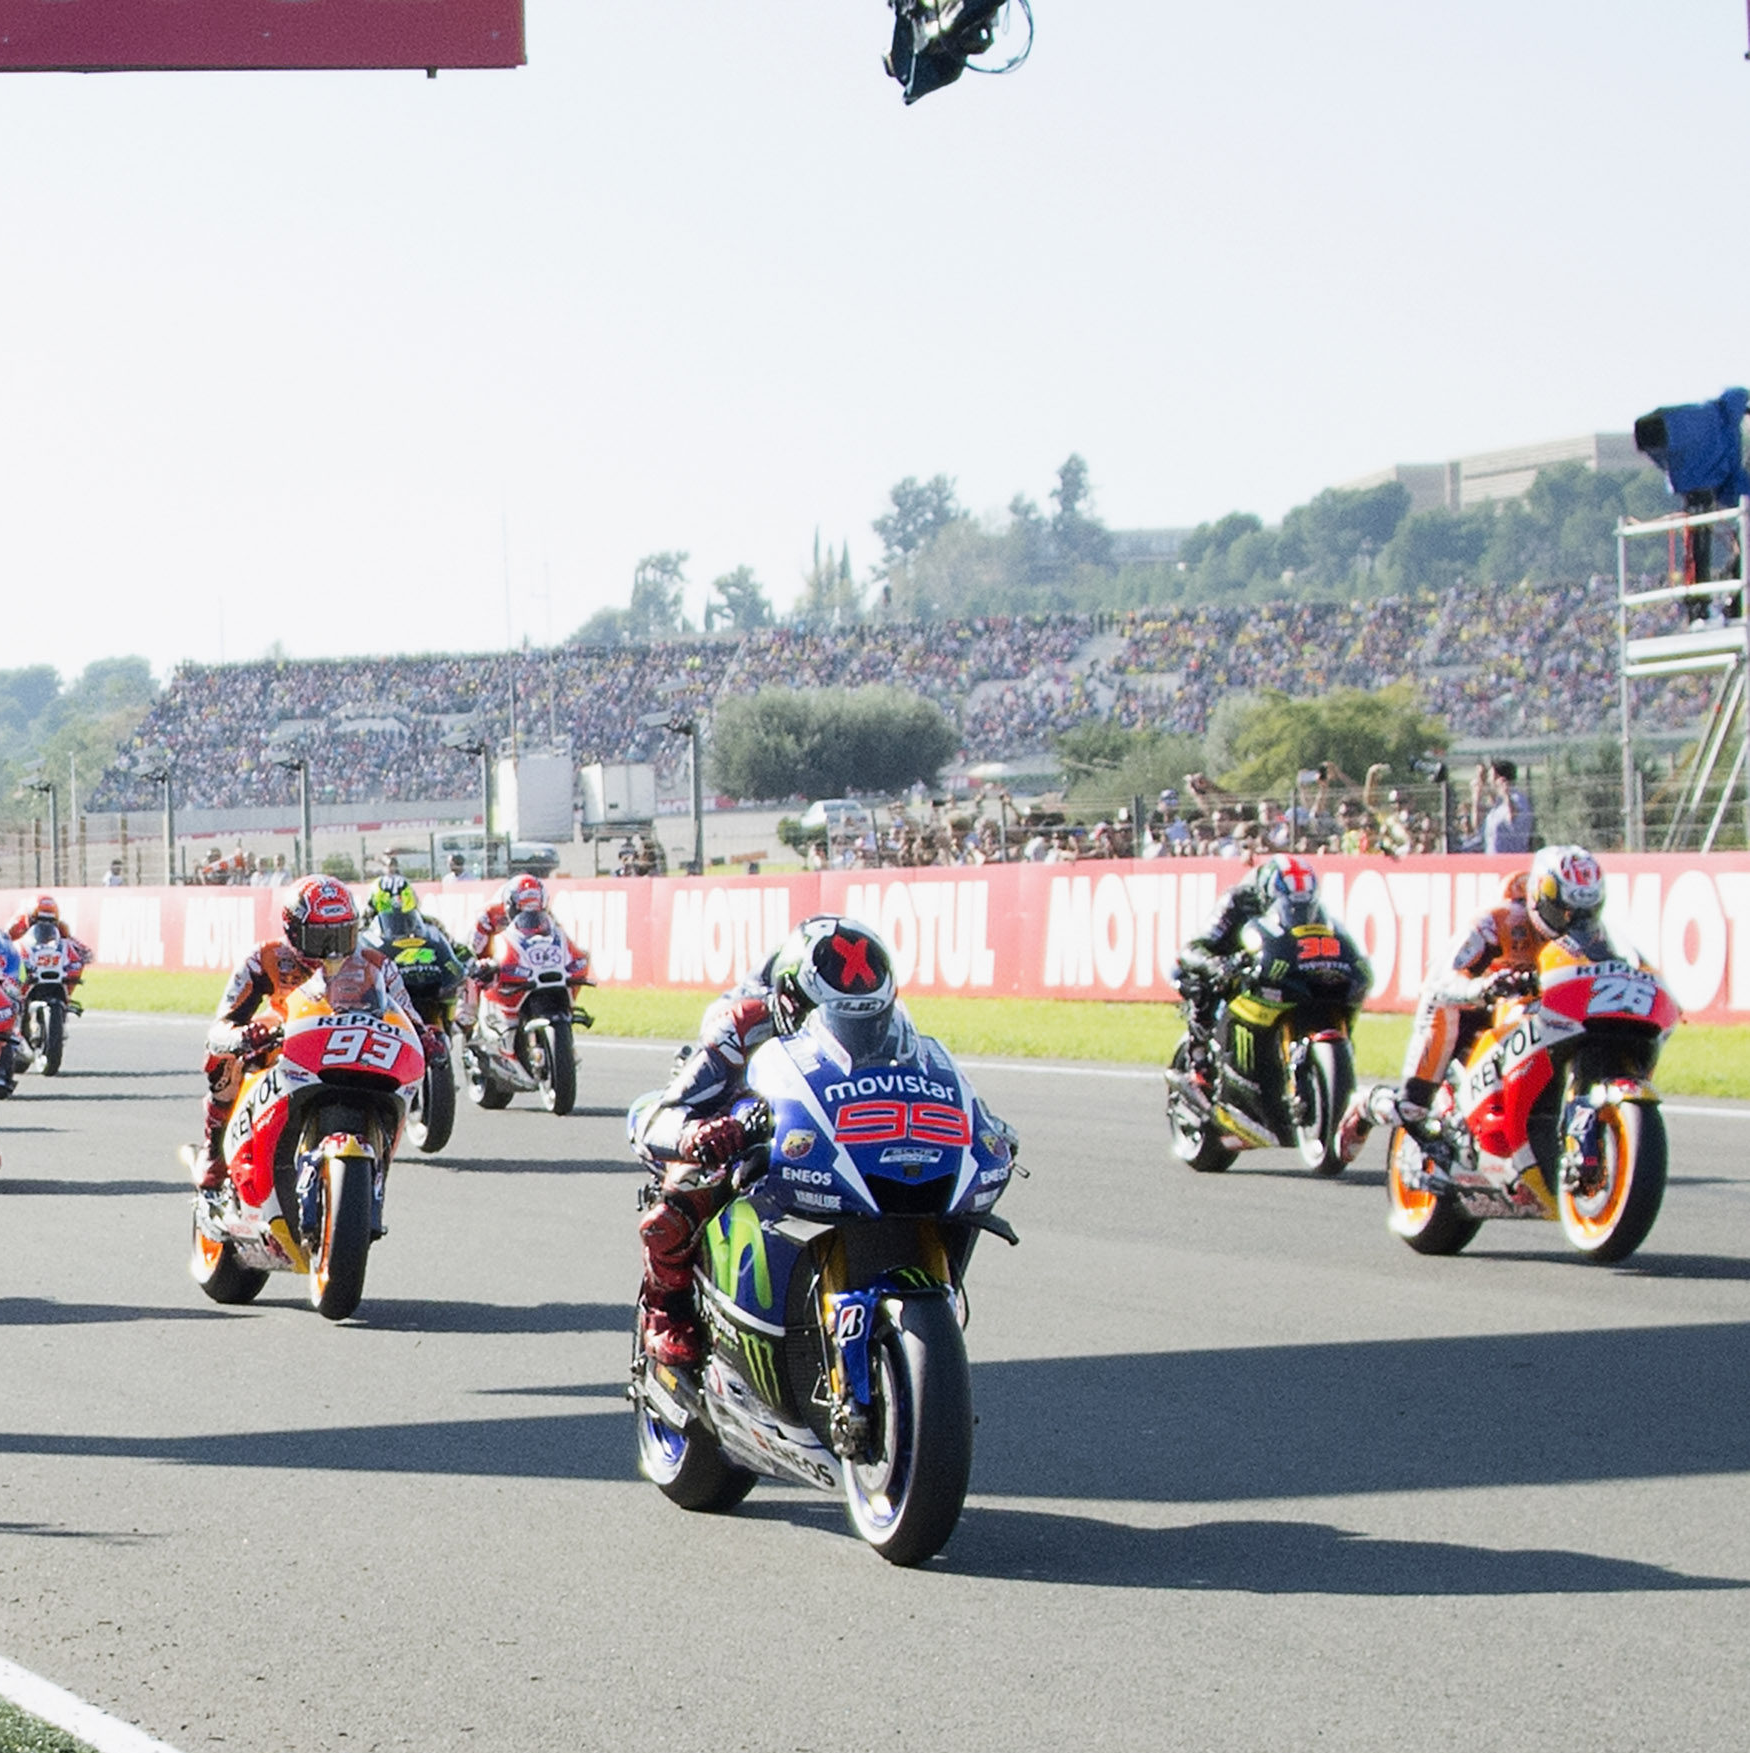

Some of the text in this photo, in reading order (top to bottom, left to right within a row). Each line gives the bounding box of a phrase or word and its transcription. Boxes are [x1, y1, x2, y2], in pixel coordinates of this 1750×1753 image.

[1586, 976, 1658, 1017] 26
[317, 1015, 402, 1037] REPSOL
[321, 1028, 402, 1070] 93
[823, 1075, 955, 1102] movistar
[833, 1100, 973, 1146] 99
[781, 1167, 833, 1187] ENEOS
